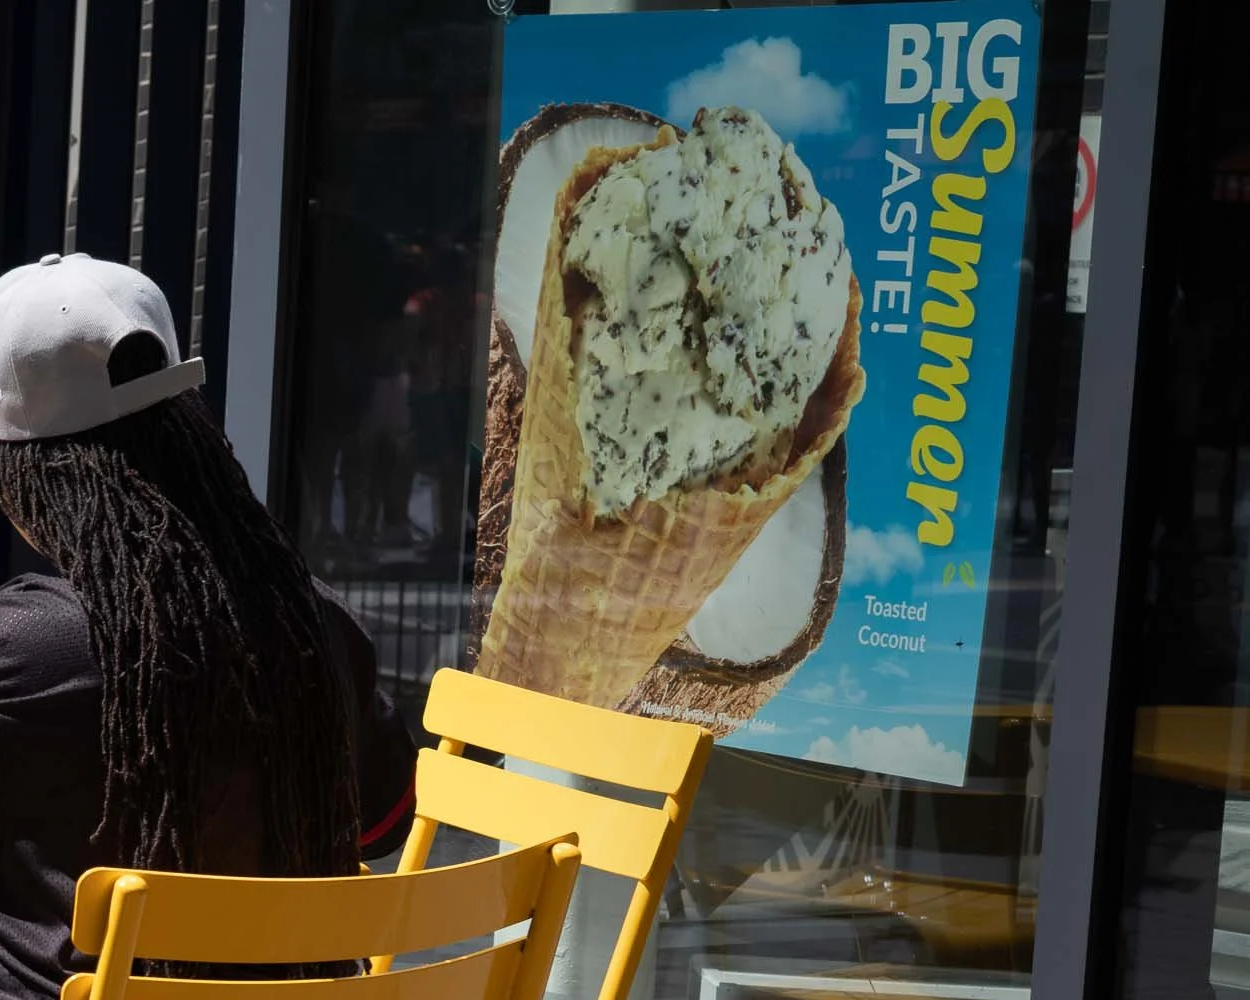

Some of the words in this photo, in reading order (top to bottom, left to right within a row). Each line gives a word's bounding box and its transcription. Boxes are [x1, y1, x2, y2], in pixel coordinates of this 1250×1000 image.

[885, 19, 1022, 104] BIG
[870, 113, 925, 334] TASTE!
[906, 97, 1016, 547] Summer
[858, 625, 927, 653] Coconut
[864, 594, 928, 622] Toasted
